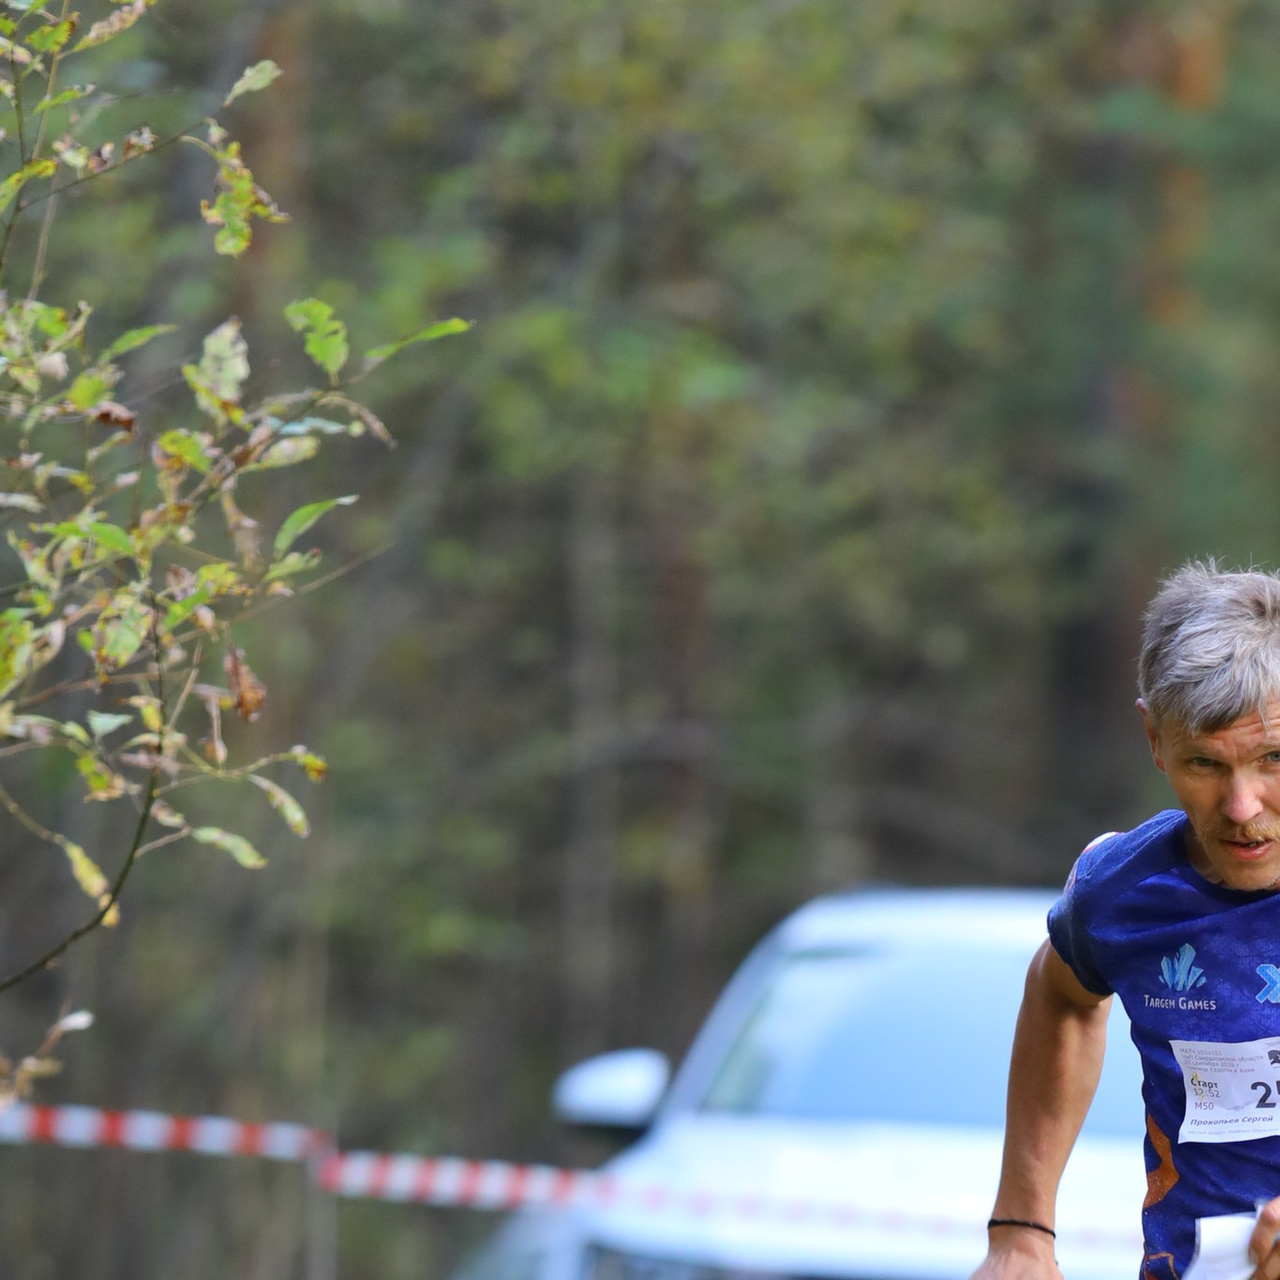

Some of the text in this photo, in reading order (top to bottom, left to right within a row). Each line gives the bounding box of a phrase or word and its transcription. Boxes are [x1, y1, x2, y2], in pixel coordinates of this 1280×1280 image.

[1190, 1077, 1219, 1090] Старт
[1190, 1115, 1274, 1127] Прокопьев Сергей
